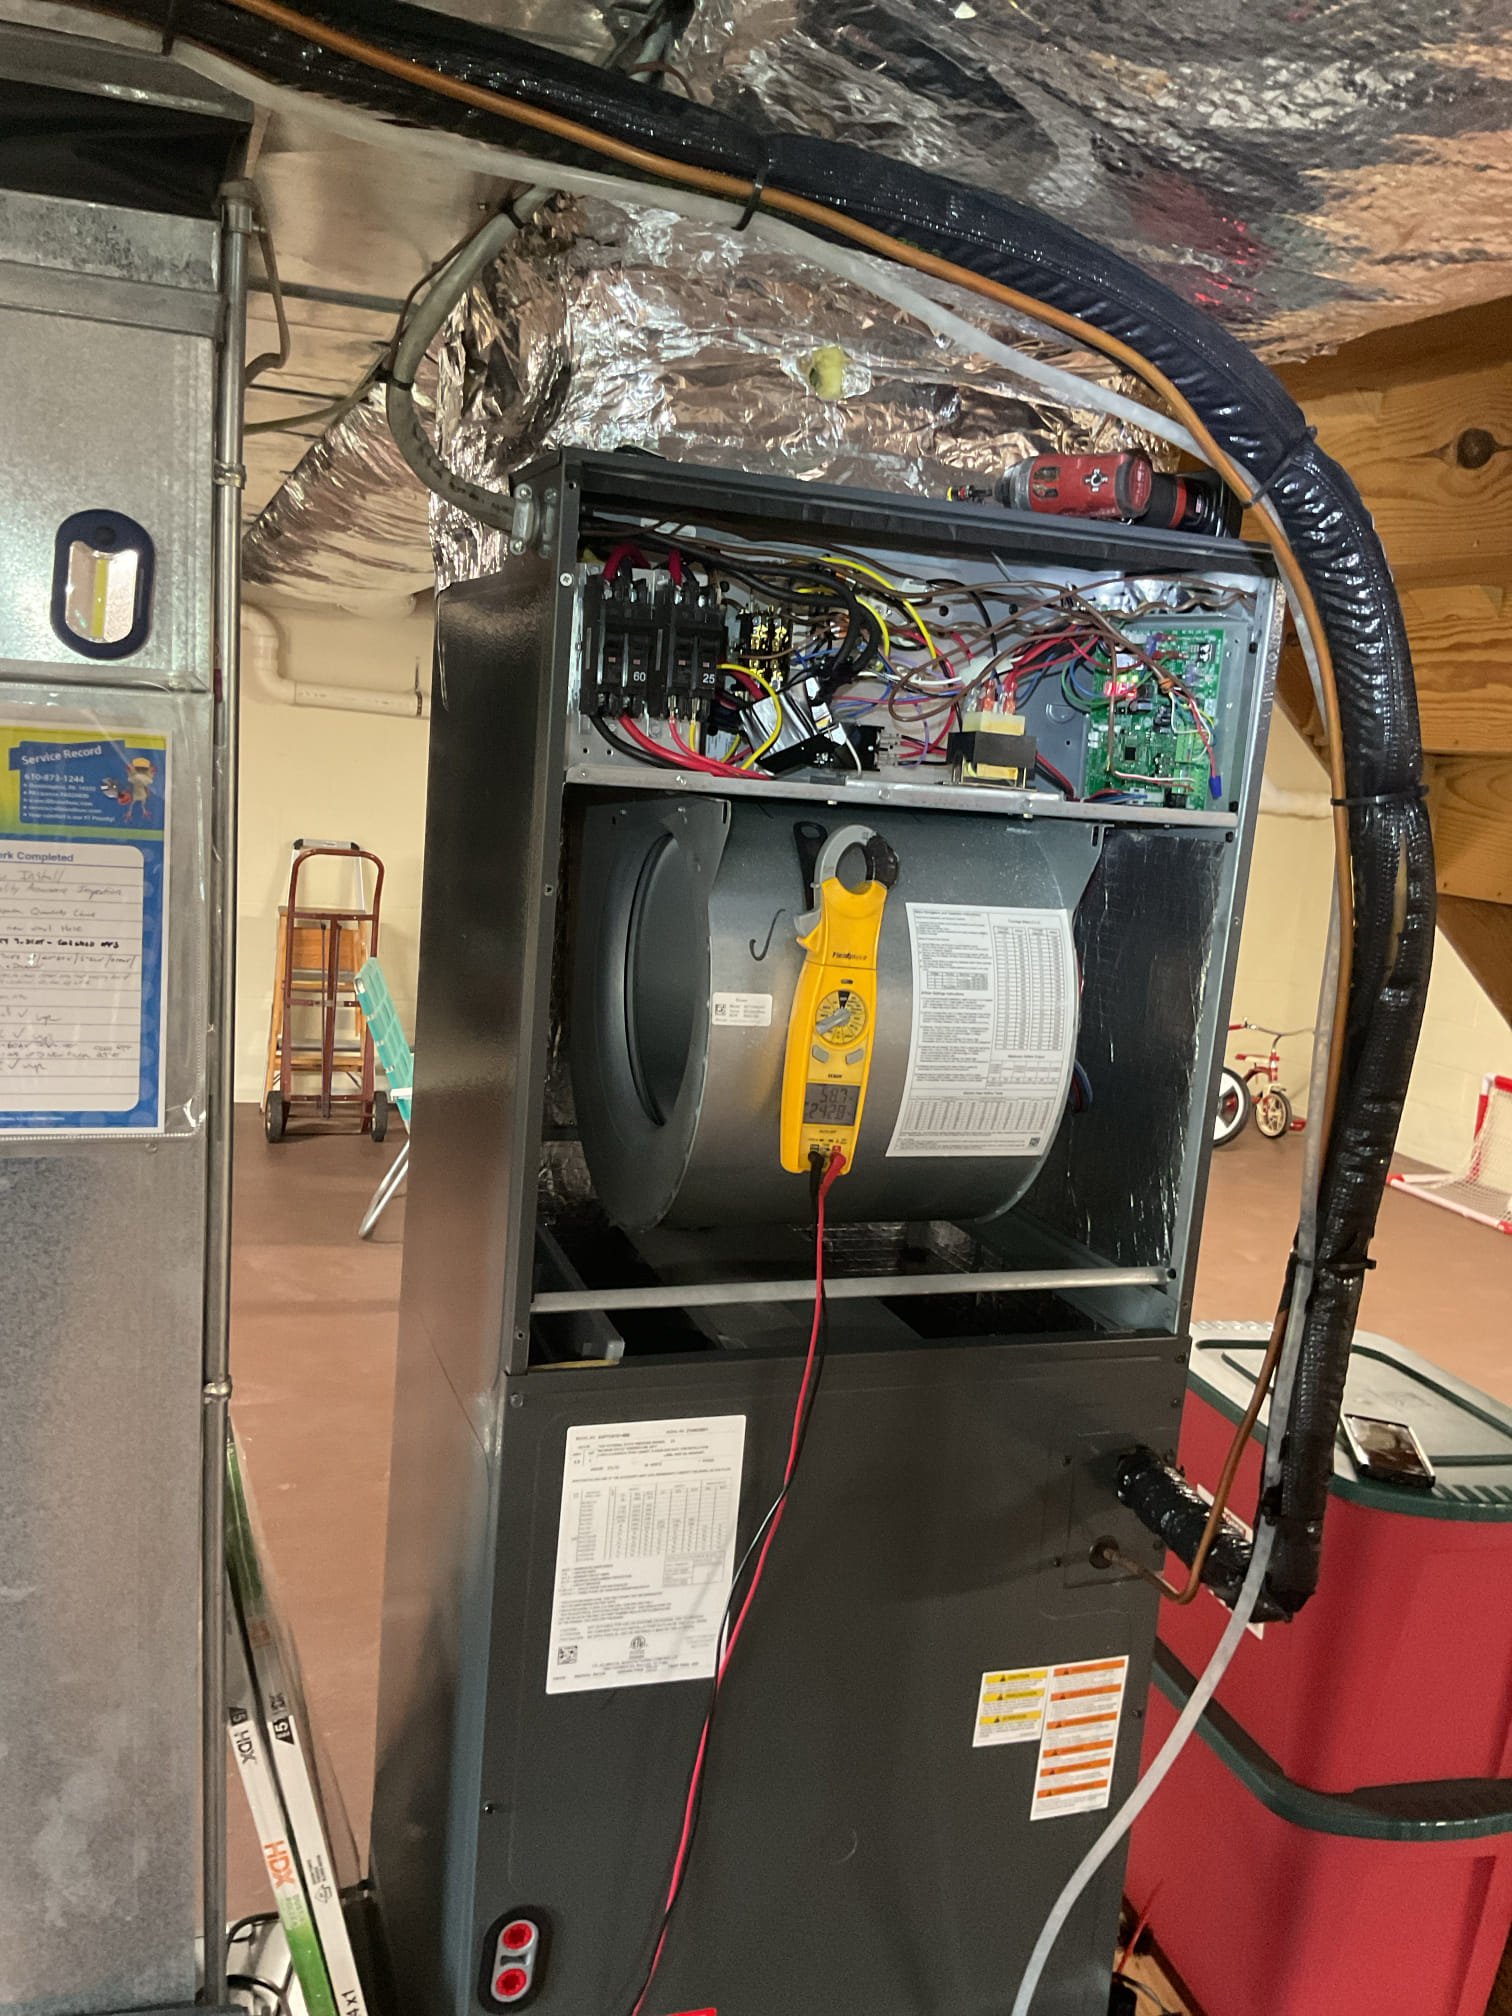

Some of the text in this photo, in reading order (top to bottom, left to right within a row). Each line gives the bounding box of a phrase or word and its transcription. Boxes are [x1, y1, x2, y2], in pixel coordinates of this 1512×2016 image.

[633, 671, 646, 682] 60
[702, 673, 715, 684] 25
[21, 745, 102, 765] Service Record
[17, 851, 74, 863] Completed
[233, 1729, 257, 1764] HDX
[264, 1840, 296, 1889] HDX
